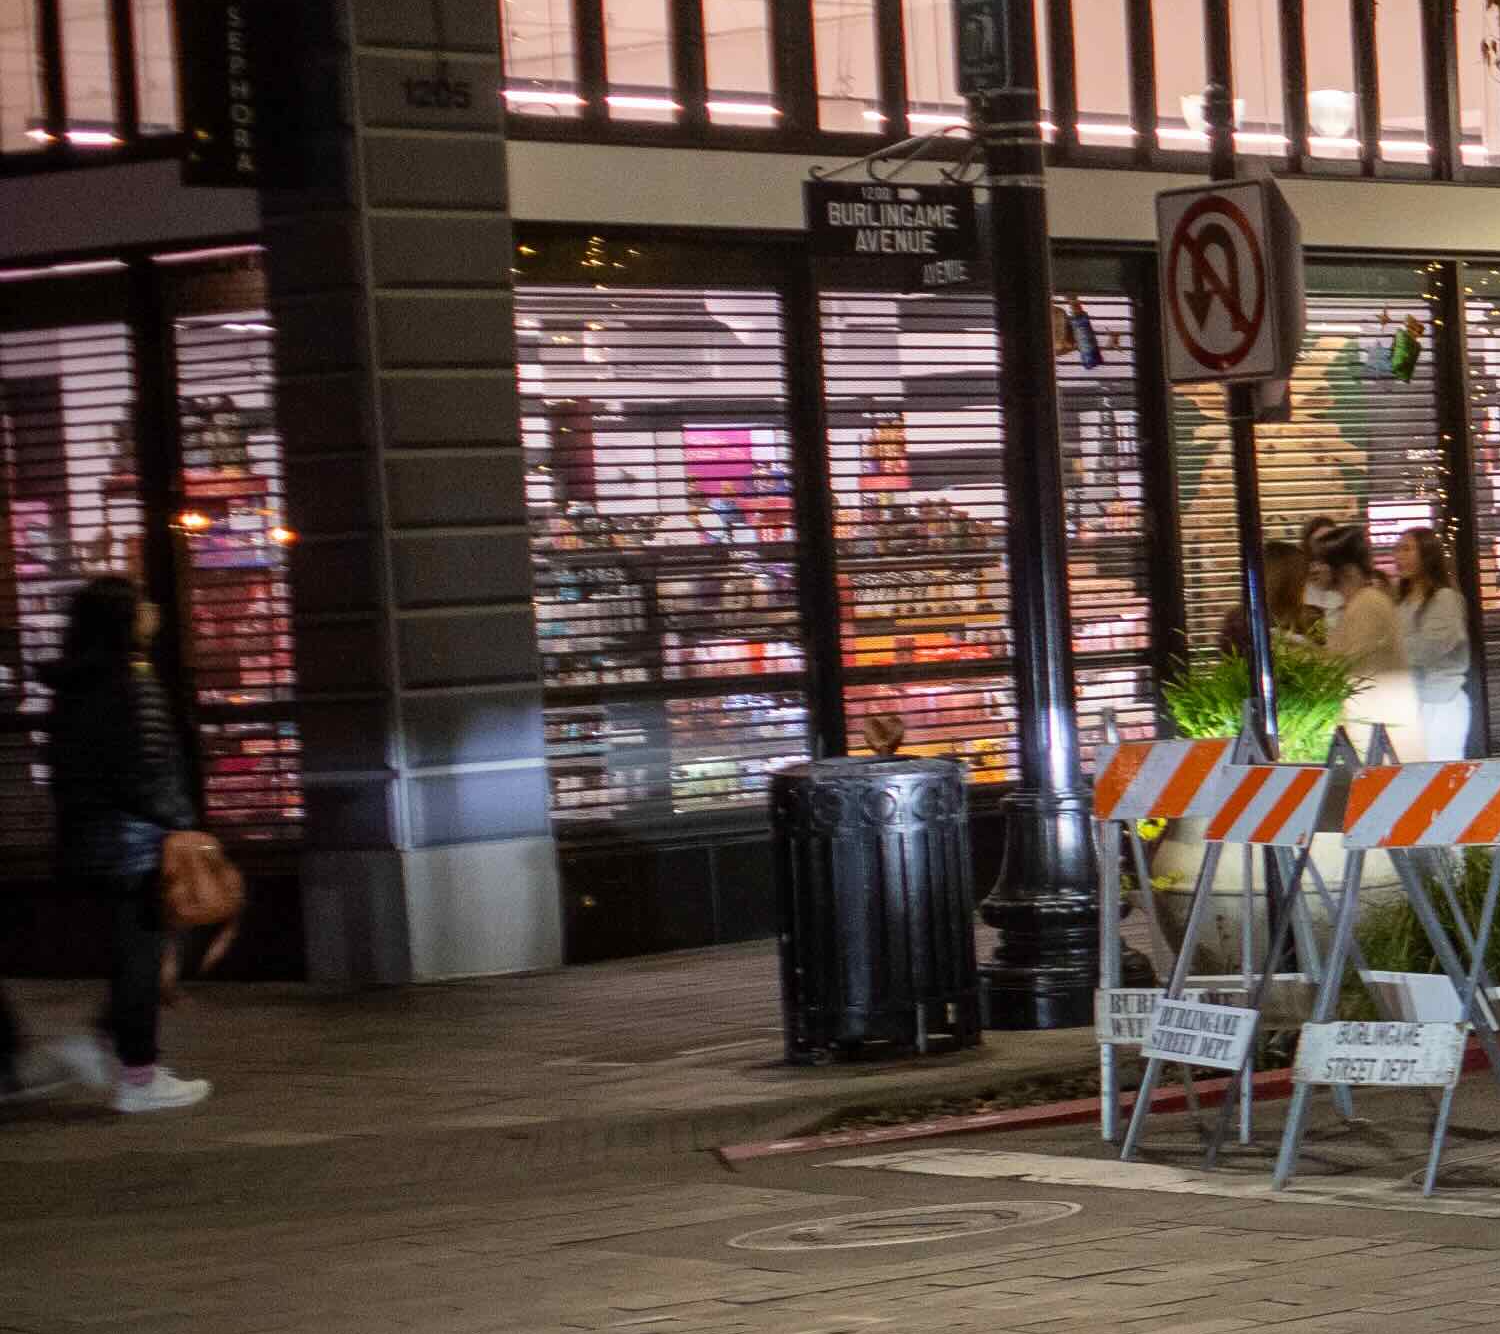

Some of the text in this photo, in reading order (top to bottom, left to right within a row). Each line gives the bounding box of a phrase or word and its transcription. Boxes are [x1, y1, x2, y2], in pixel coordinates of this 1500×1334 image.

[226, 4, 254, 172] SEPHORA
[827, 202, 959, 229] BURLINGAME
[855, 229, 938, 254] AVENUE
[1158, 1005, 1241, 1037] BURLINGAME
[1335, 1022, 1424, 1046] BURLINGAME
[1152, 1029, 1193, 1055] STREET
[1326, 1057, 1377, 1081] STREET
